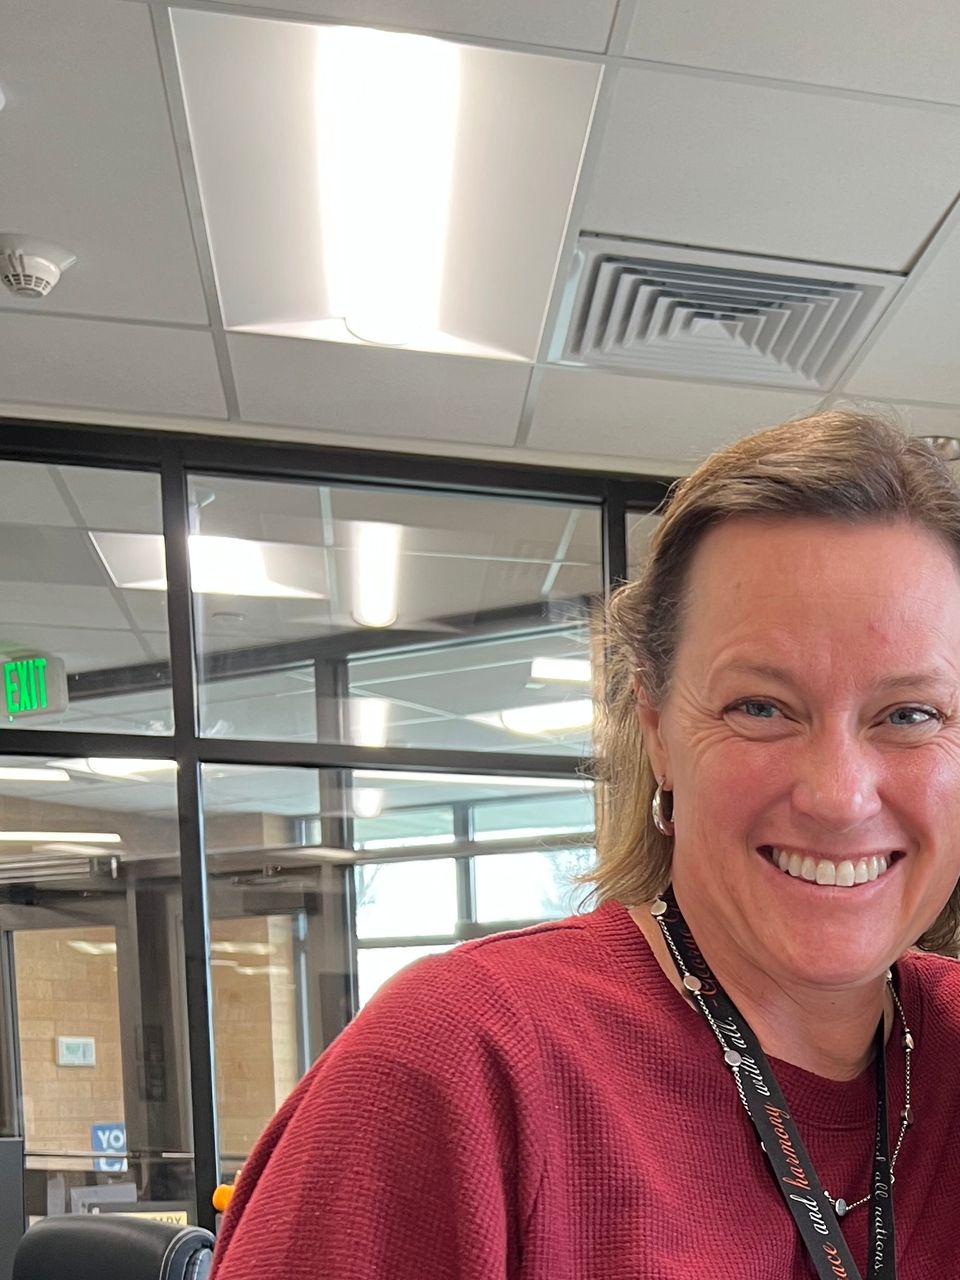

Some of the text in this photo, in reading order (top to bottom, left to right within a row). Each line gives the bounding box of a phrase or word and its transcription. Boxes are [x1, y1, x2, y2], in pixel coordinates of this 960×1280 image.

[4, 658, 47, 712] EXIT
[741, 1054, 770, 1096] with
[97, 1129, 126, 1150] YO
[763, 1102, 811, 1190] harmony
[874, 1171, 889, 1198] all
[789, 1194, 829, 1235] and
[873, 1206, 888, 1277] nations.
